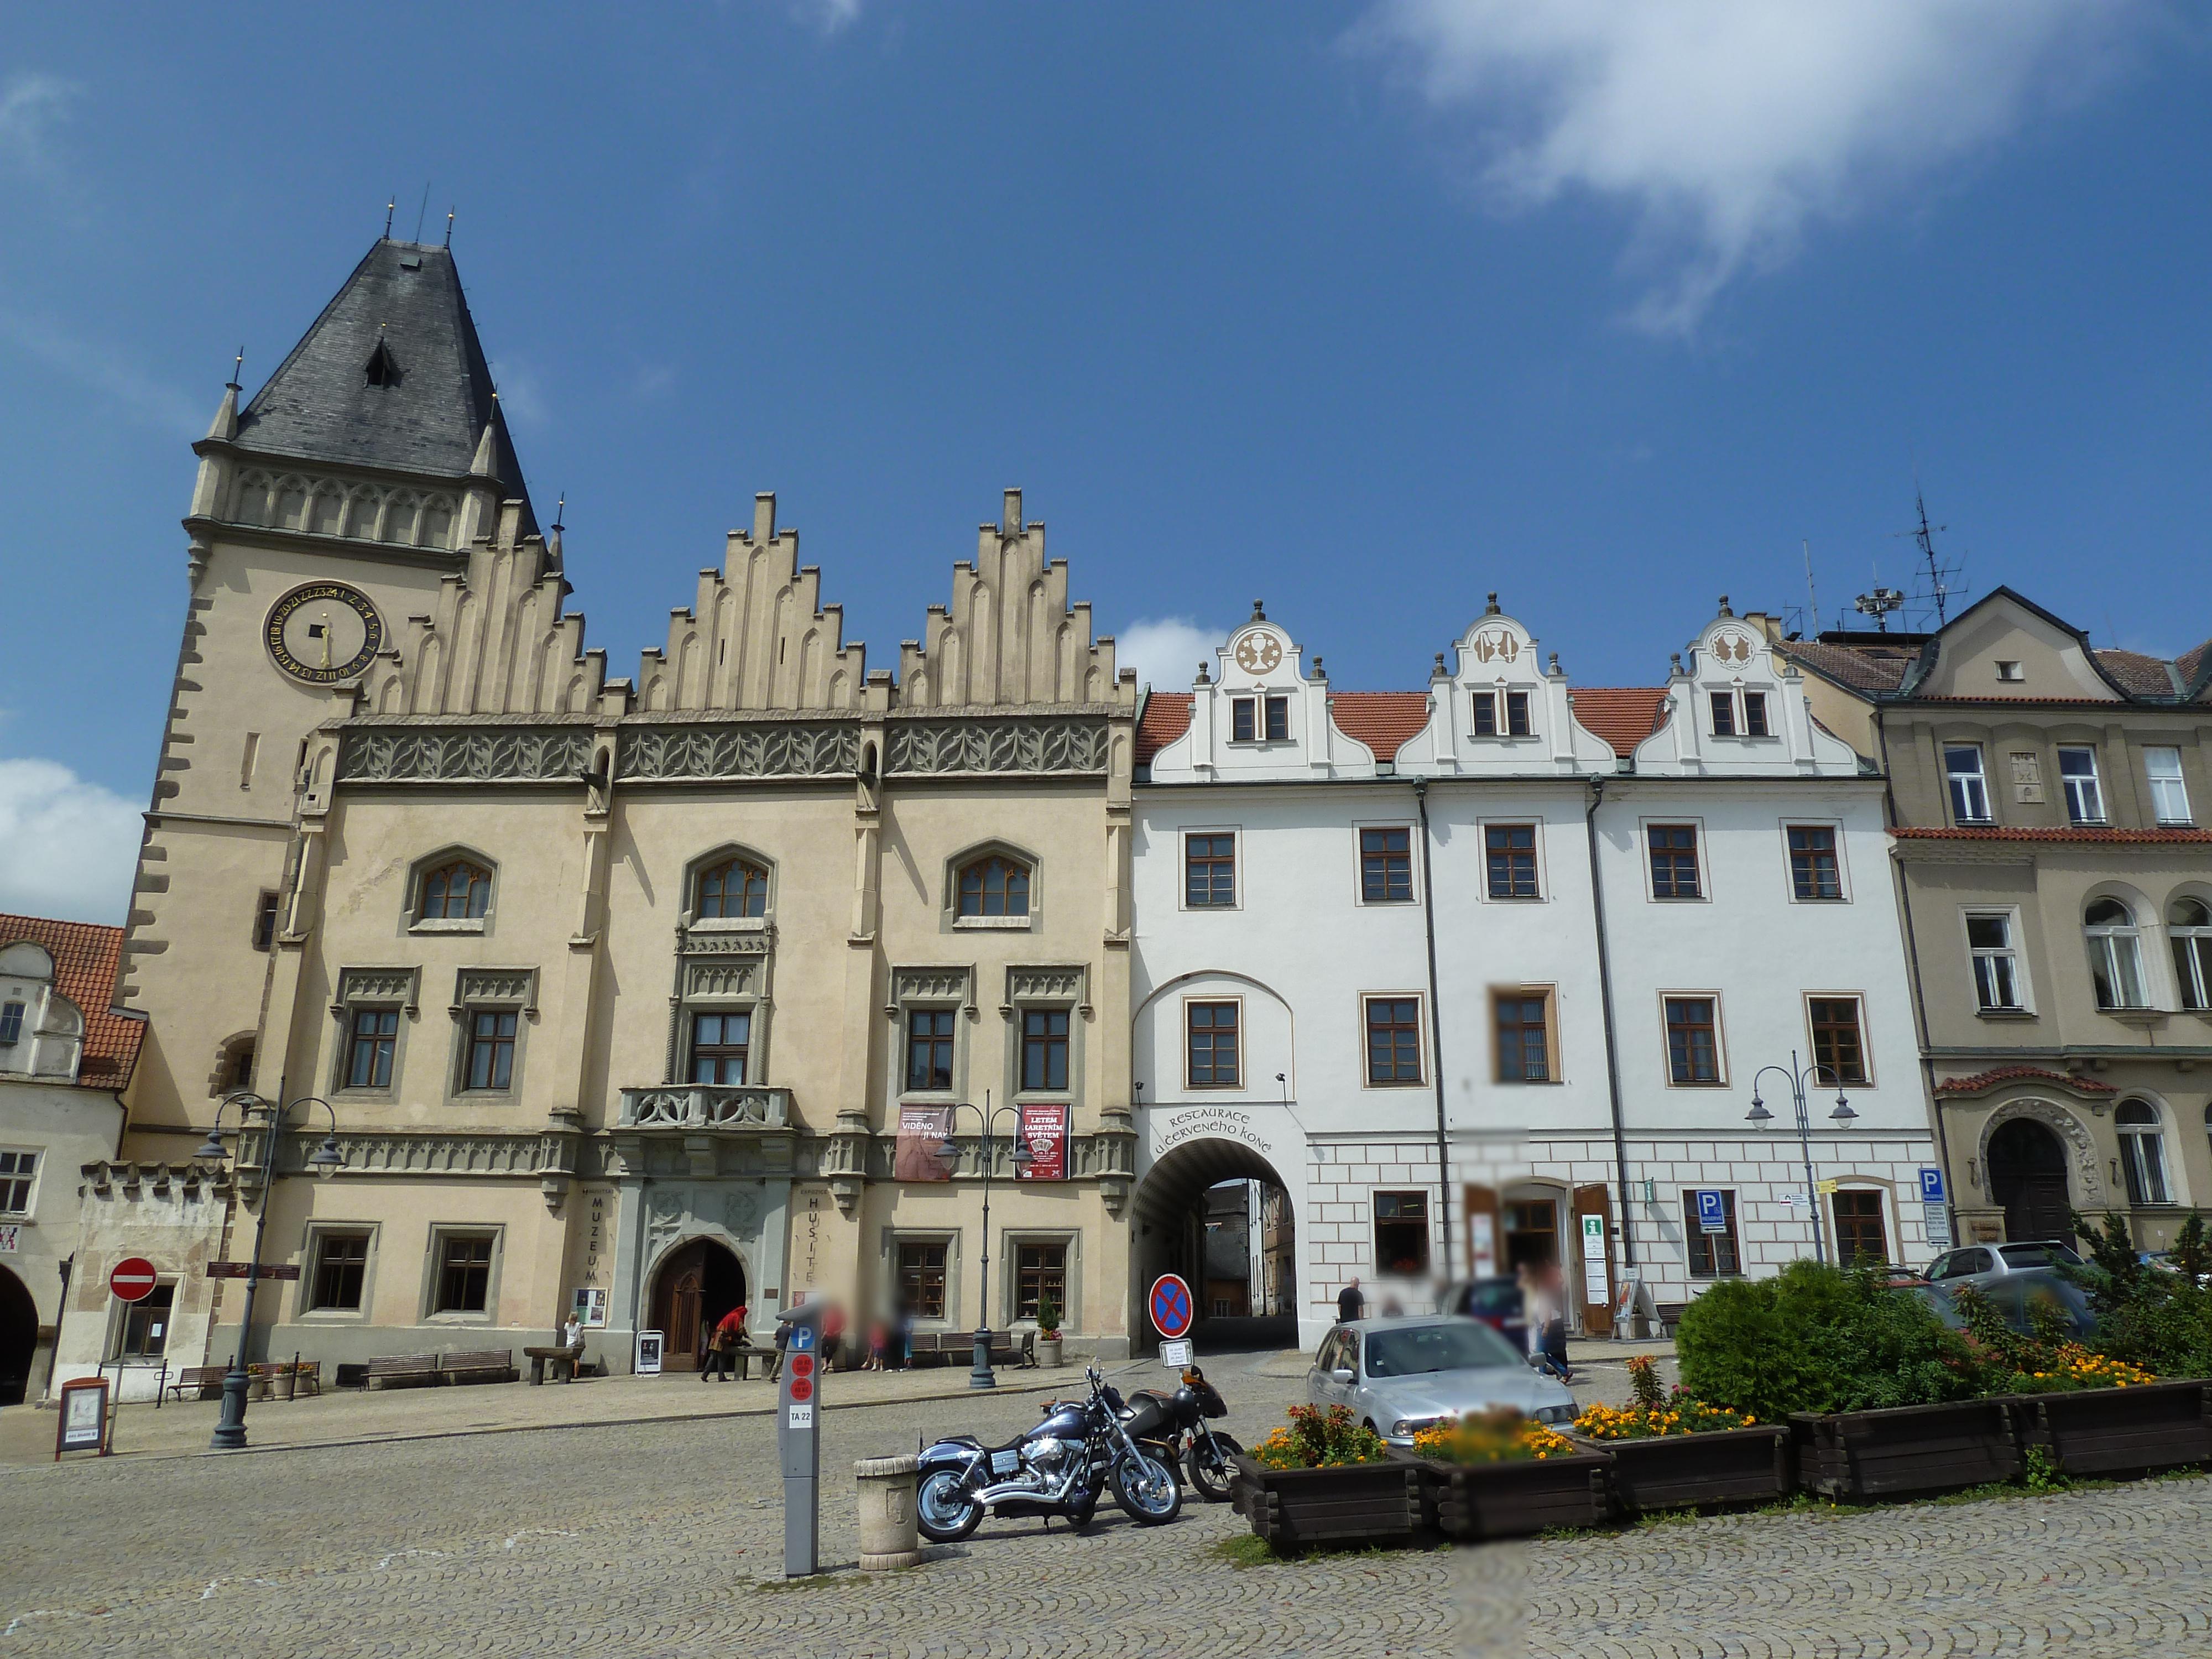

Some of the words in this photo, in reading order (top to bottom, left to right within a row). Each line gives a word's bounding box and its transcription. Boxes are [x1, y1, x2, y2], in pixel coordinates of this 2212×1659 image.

[1169, 1108, 1250, 1127] RESTAURACE
[1156, 1145, 1165, 1154] U
[1923, 1172, 1938, 1192] P
[1702, 1194, 1717, 1214] P
[586, 1197, 602, 1280] MUZEUM
[798, 1327, 812, 1348] P
[791, 1412, 800, 1421] TA
[802, 1412, 810, 1421] 22
